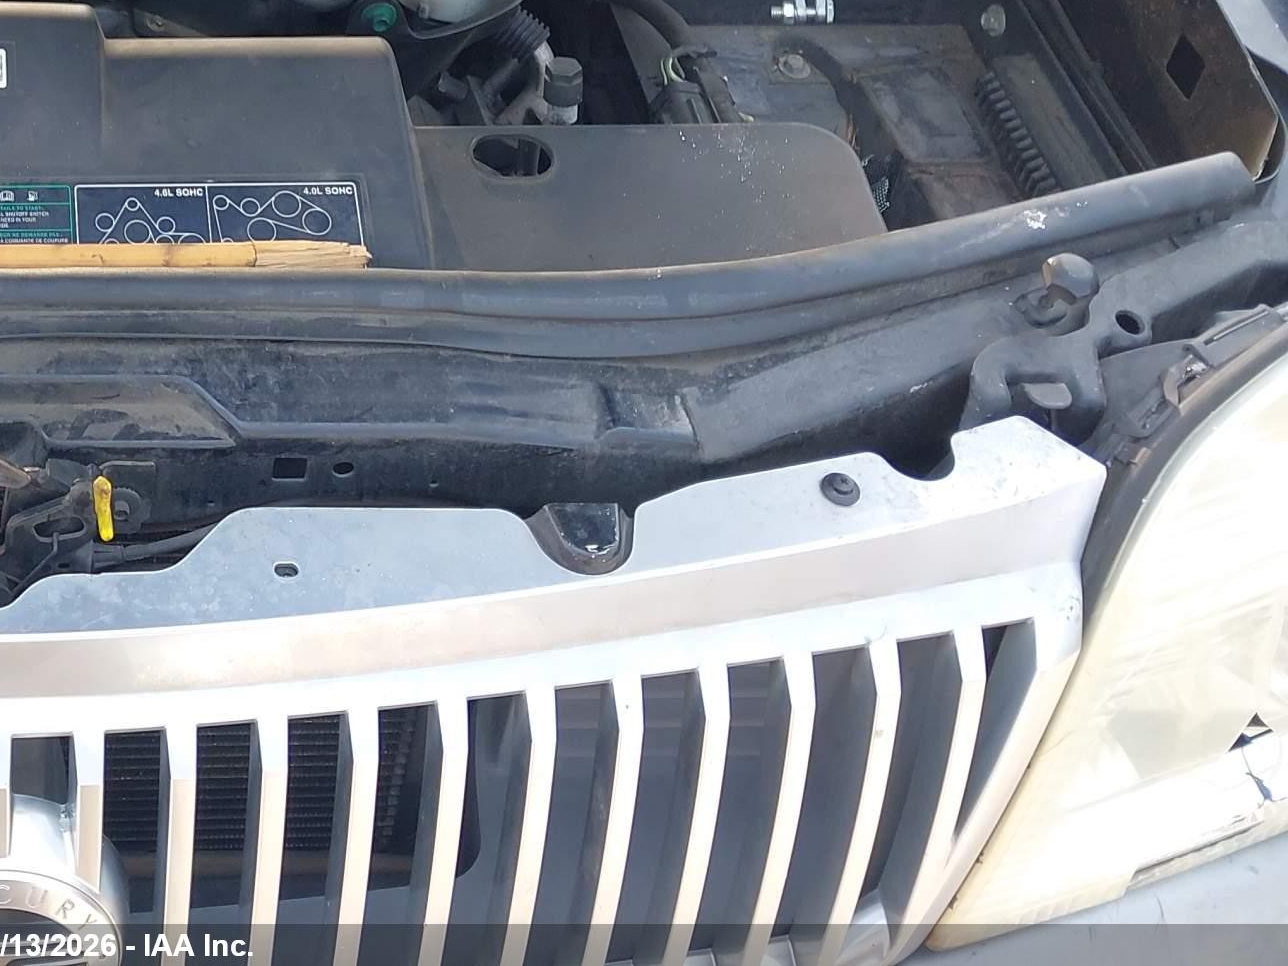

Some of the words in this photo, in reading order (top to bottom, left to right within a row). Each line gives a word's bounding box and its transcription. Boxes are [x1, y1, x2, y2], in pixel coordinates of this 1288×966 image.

[175, 187, 204, 198] SOHC
[302, 186, 324, 196] 4.0L
[324, 186, 354, 196] SOHC
